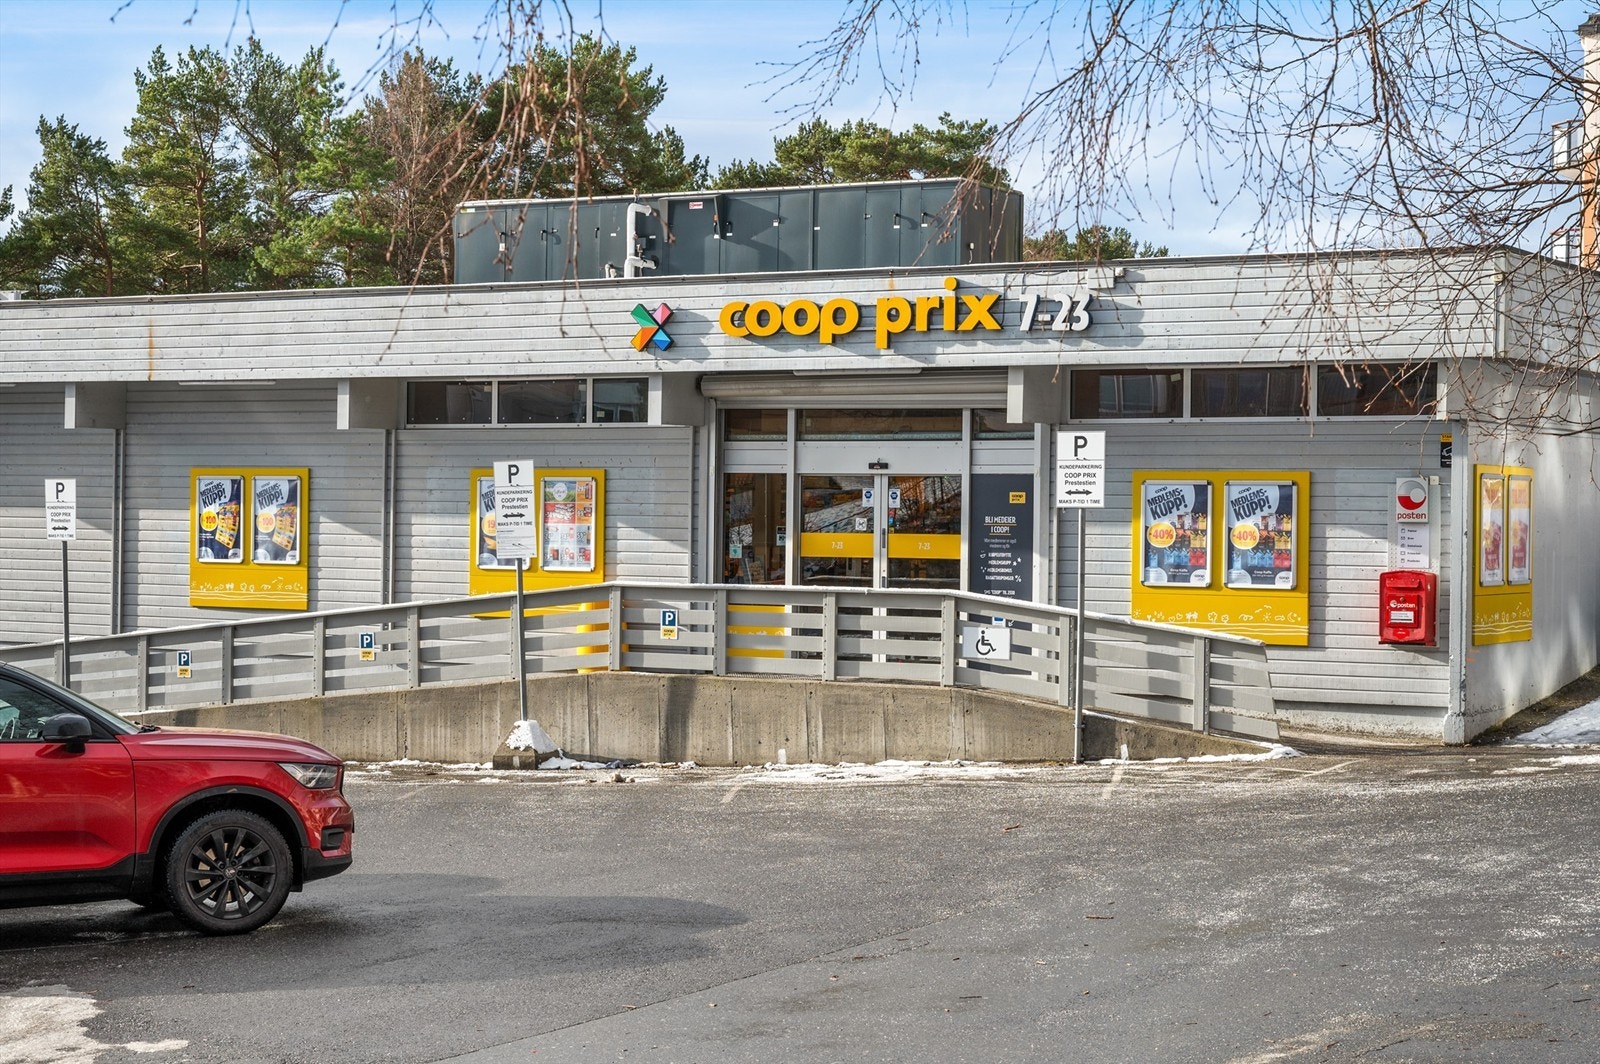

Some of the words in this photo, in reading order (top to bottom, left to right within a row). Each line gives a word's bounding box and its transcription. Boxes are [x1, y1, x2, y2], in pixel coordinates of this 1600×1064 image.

[719, 297, 860, 345] coop
[876, 276, 1002, 350] prix
[1018, 293, 1093, 332] 7-23
[1074, 436, 1088, 457] P
[508, 464, 520, 484] P
[56, 482, 65, 500] P
[202, 488, 227, 509] KUPP!
[258, 489, 284, 510] KUPP!
[1147, 487, 1183, 508] MEDLEMS-
[1230, 488, 1267, 509] MEDLEMS-
[1150, 495, 1188, 521] KUPP!
[1233, 495, 1272, 522] KUPP!
[1396, 511, 1427, 521] posten
[1149, 529, 1174, 540] -40%
[1232, 530, 1257, 541] -40%
[831, 541, 844, 550] 7-23
[918, 542, 931, 550] 7-23
[665, 612, 674, 625] P
[363, 635, 371, 648] P
[181, 653, 188, 665] P
